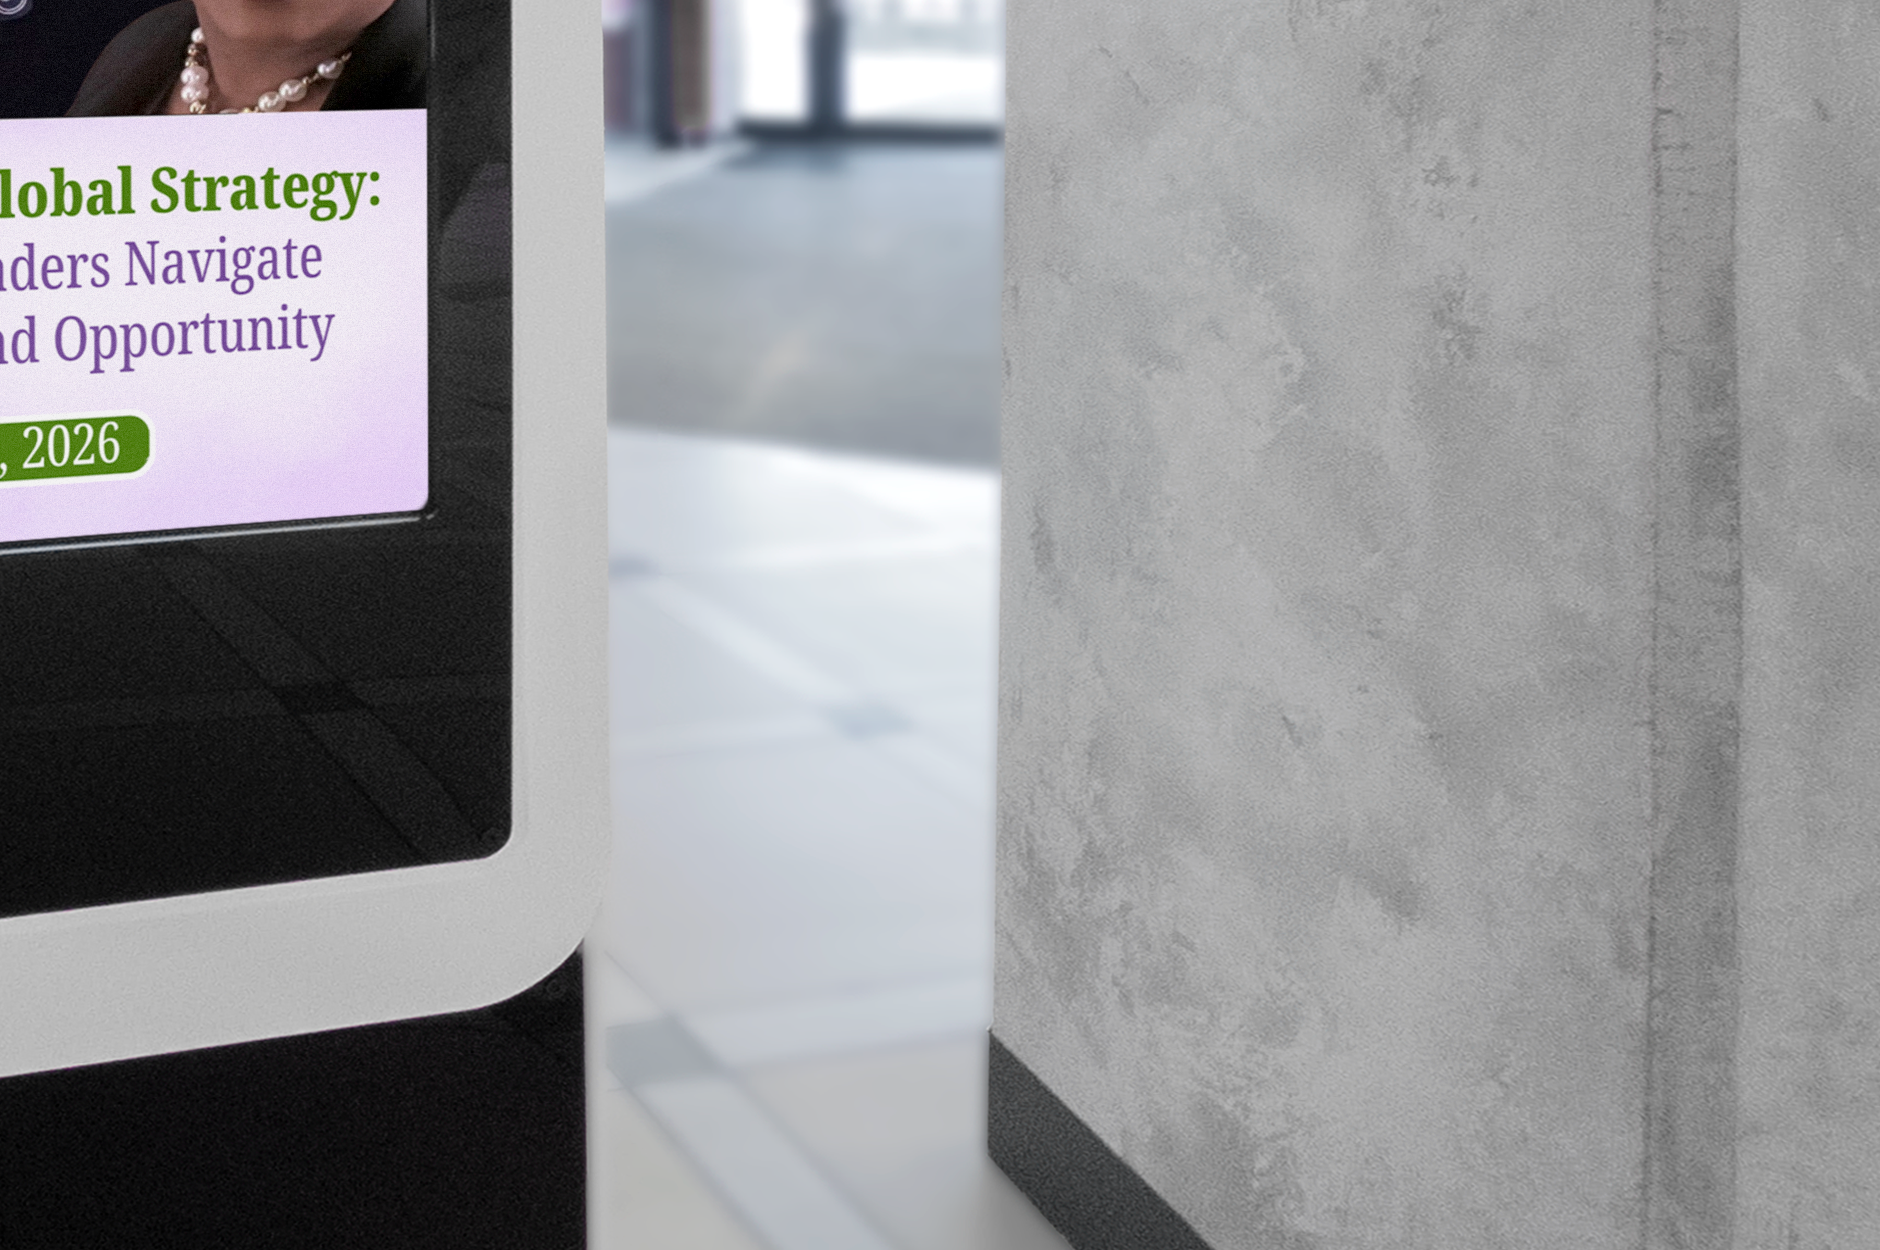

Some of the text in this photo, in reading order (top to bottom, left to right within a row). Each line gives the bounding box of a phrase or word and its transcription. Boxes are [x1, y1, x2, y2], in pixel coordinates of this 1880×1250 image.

[151, 166, 381, 221] Strategy:
[125, 236, 322, 294] Navigate
[55, 304, 335, 373] Opportunity
[22, 420, 120, 469] 2026
